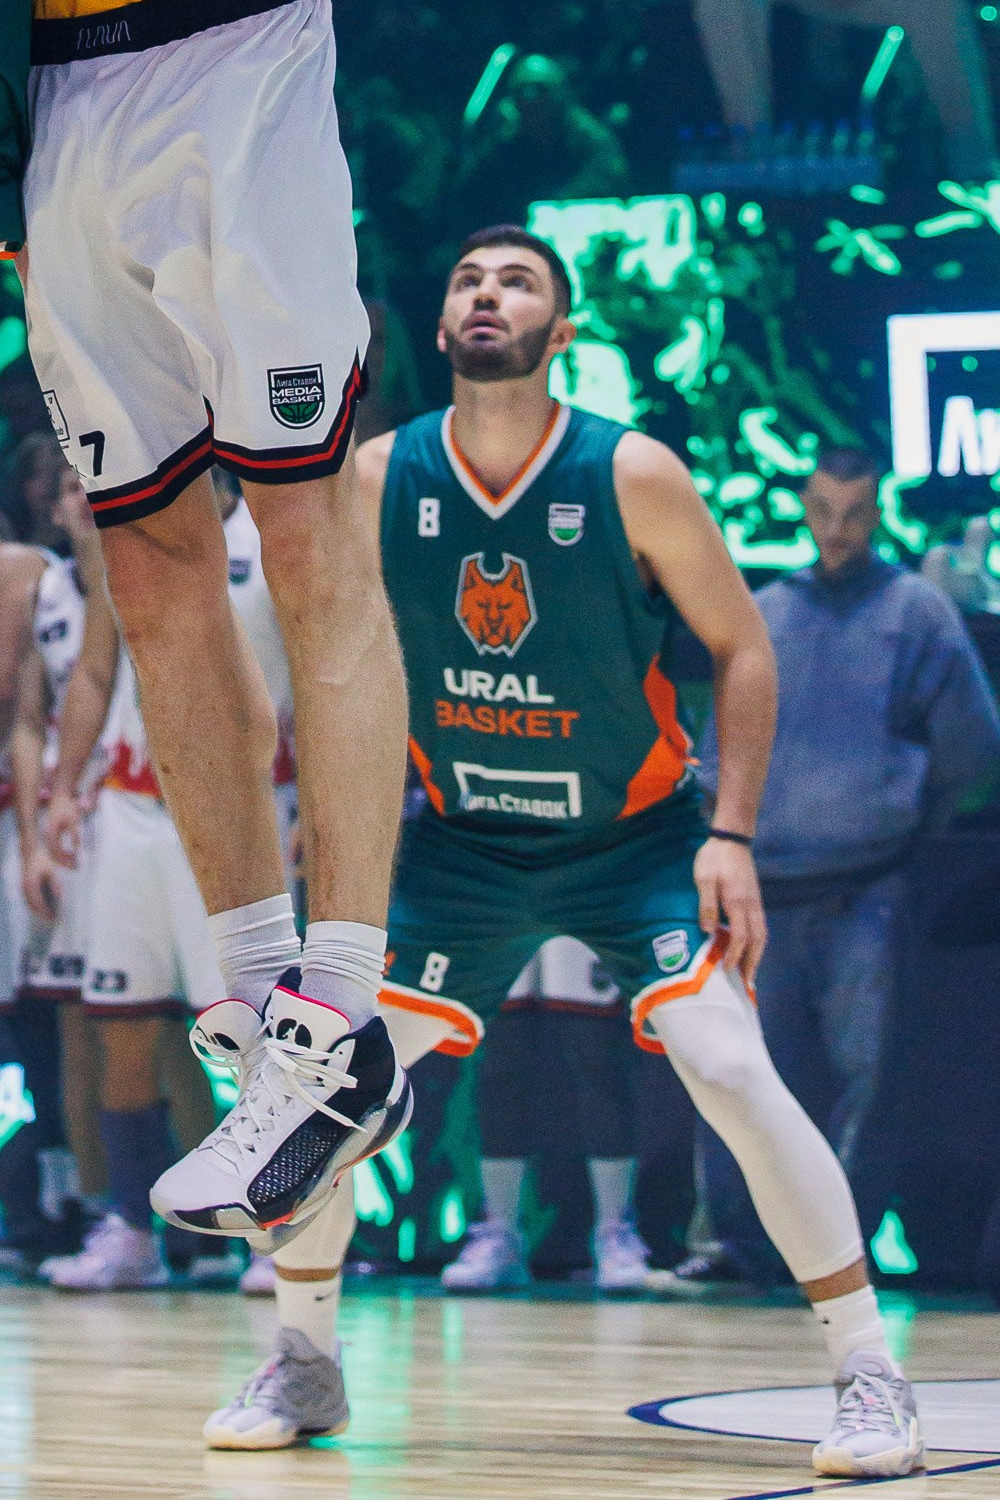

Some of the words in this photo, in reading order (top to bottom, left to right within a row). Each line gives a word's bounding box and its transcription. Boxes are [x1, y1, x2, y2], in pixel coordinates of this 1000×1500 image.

[271, 385, 322, 398] MEDIA
[272, 393, 323, 405] BASKET
[78, 430, 105, 478] 7
[418, 497, 441, 538] 8
[443, 667, 556, 705] URAL
[435, 699, 580, 739] BASKET
[420, 952, 451, 992] 8
